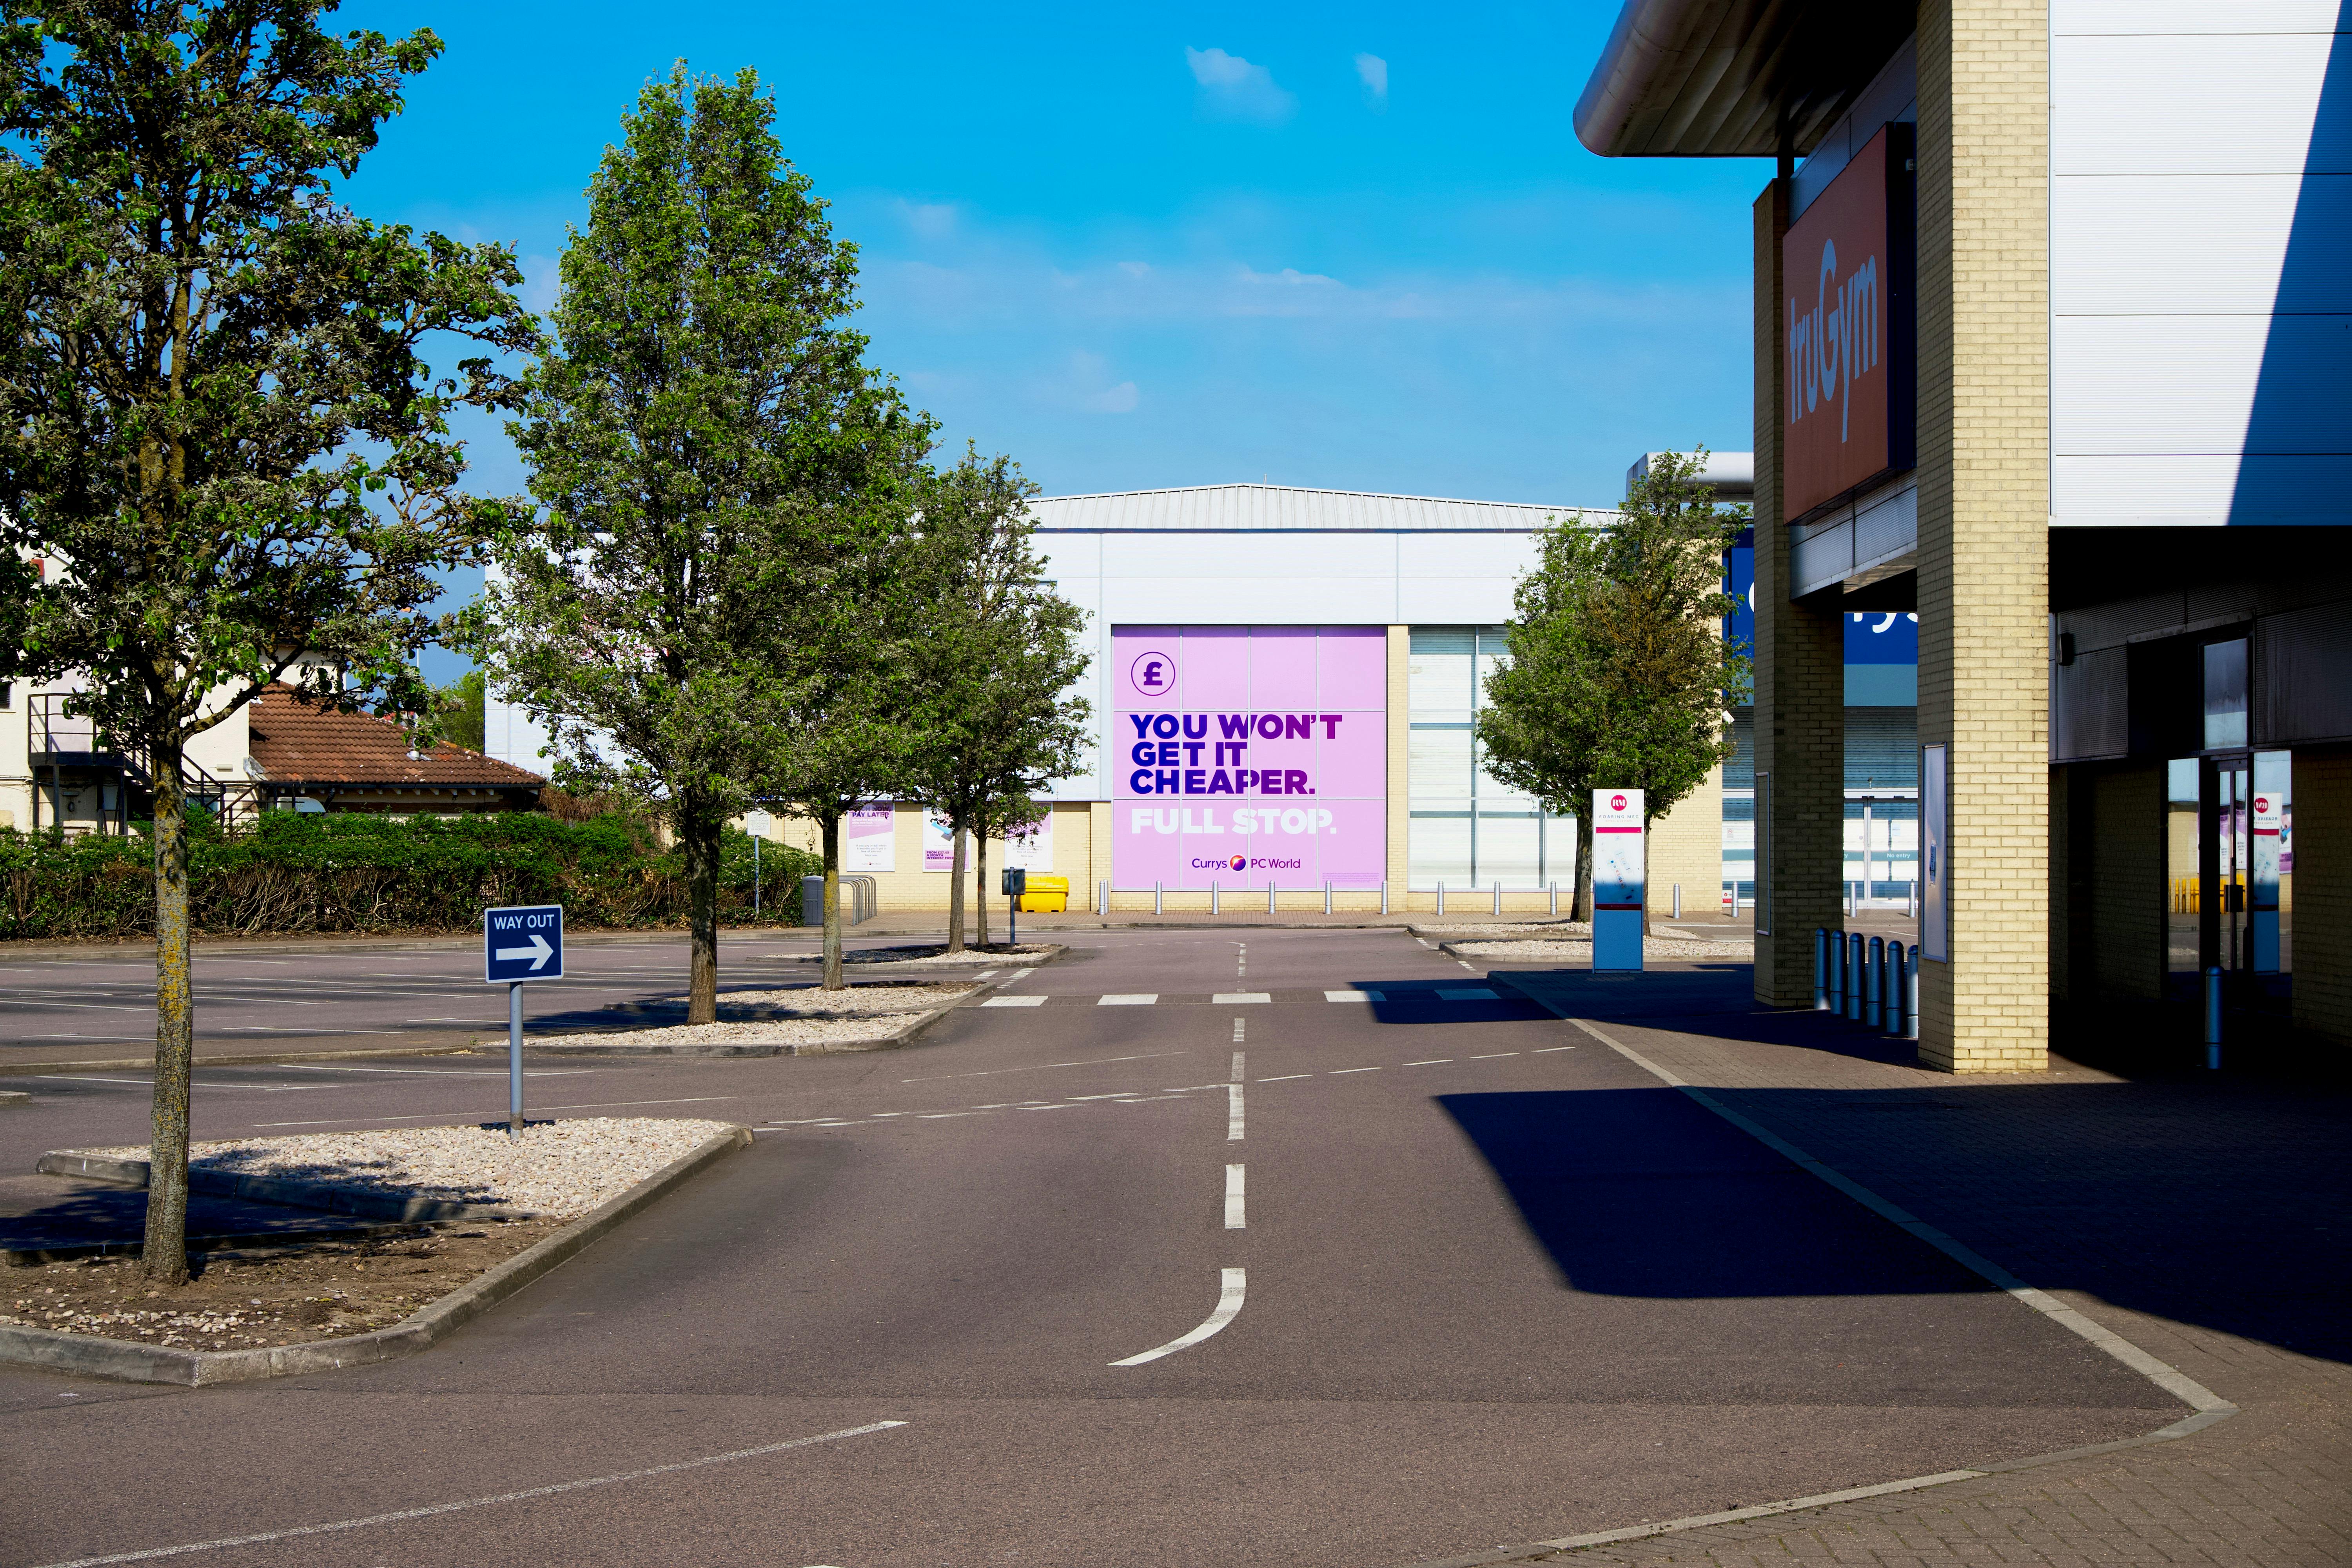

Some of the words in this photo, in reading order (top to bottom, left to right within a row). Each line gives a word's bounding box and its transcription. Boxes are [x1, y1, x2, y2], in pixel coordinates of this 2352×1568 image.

[1790, 238, 1877, 443] truGym
[1143, 661, 1163, 686] £
[1129, 714, 1207, 739] YOU
[1218, 714, 1342, 739] WON'T
[1131, 742, 1205, 766] GET
[1216, 742, 1247, 766] IT
[1130, 769, 1315, 795] CHEAPER.
[1132, 809, 1224, 834] FULL
[1232, 809, 1337, 834] STOP.
[1192, 858, 1227, 870] Currys
[1251, 858, 1267, 868] PC
[1269, 858, 1301, 869] World
[494, 916, 523, 929] WAY
[527, 914, 554, 928] OUT
